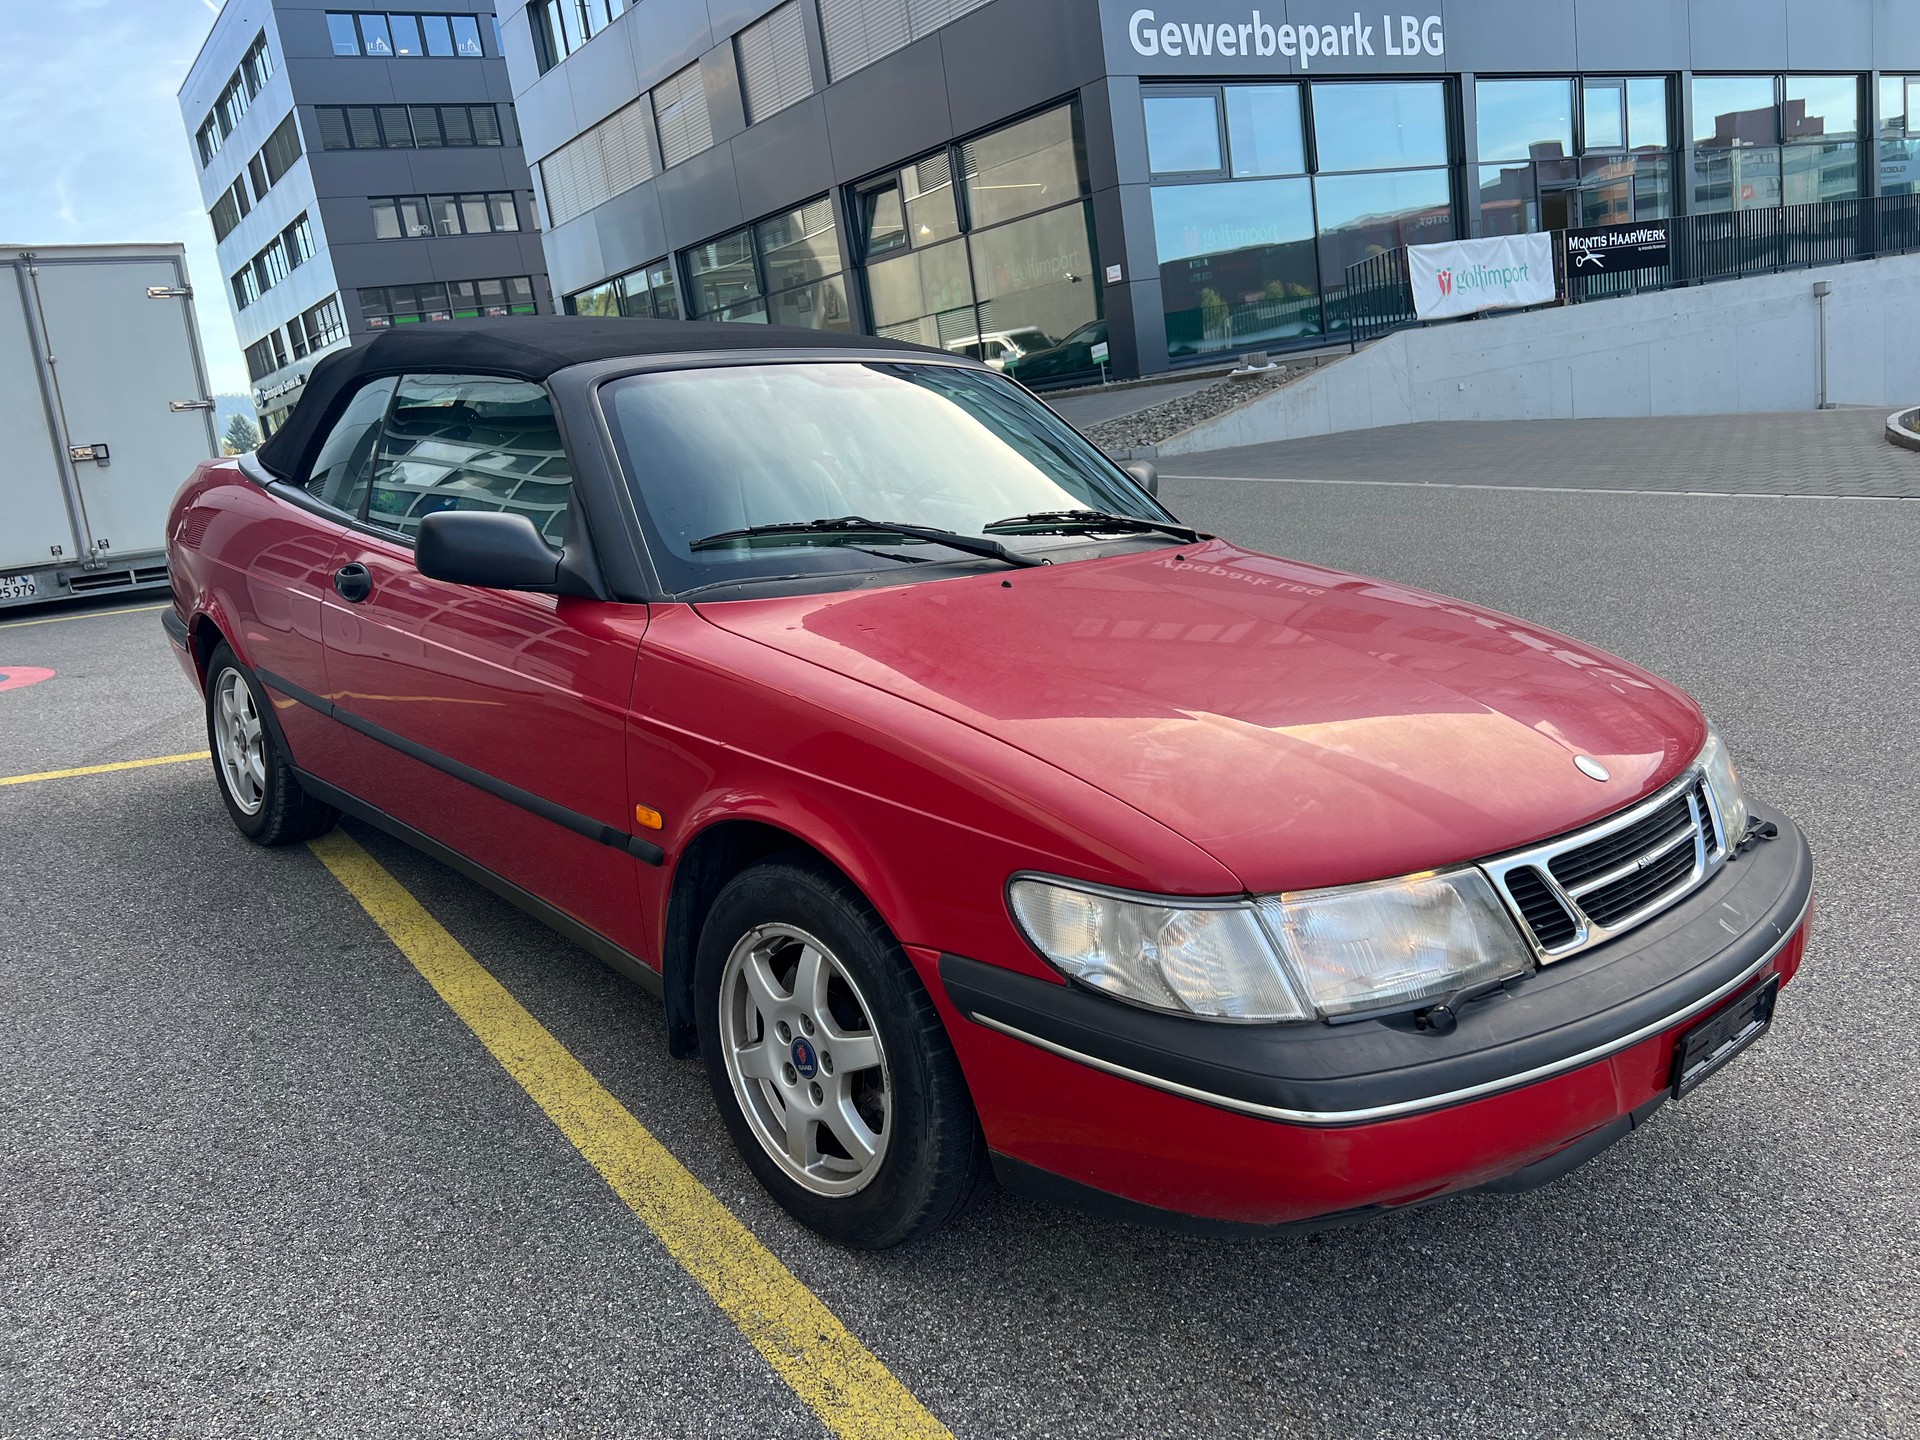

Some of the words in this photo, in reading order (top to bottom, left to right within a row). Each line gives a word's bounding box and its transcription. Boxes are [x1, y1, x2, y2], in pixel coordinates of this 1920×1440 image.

[1128, 9, 1375, 69] Gewerbepark
[1383, 14, 1445, 56] LBG
[1568, 235, 1607, 251] MONTIS
[1609, 229, 1666, 246] HAARWERK
[1456, 262, 1529, 295] golfimport
[4, 576, 16, 586] ZH
